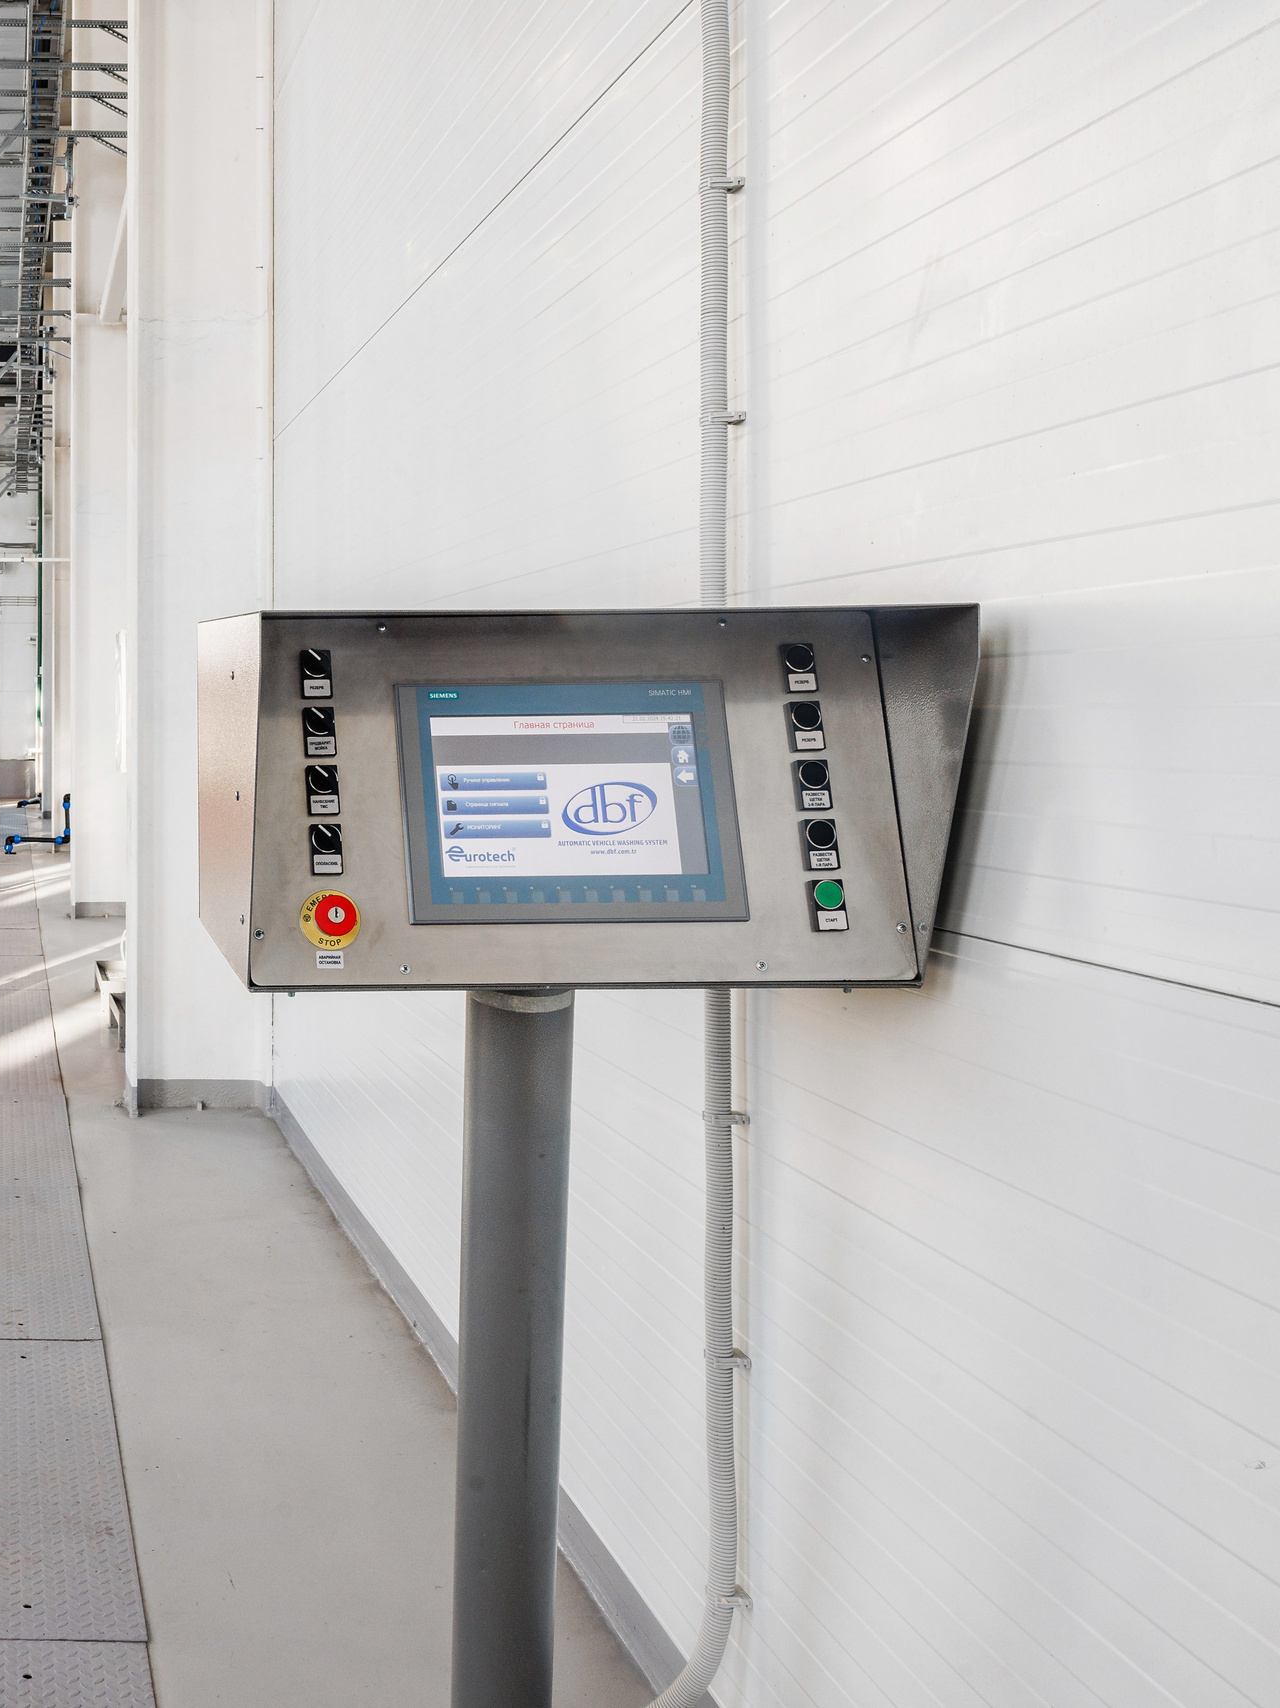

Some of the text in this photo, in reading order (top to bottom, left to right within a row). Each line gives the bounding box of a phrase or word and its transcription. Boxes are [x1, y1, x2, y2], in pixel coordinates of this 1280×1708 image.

[513, 720, 595, 730] Главная страница
[573, 784, 644, 824] dbf
[318, 937, 342, 947] STOP
